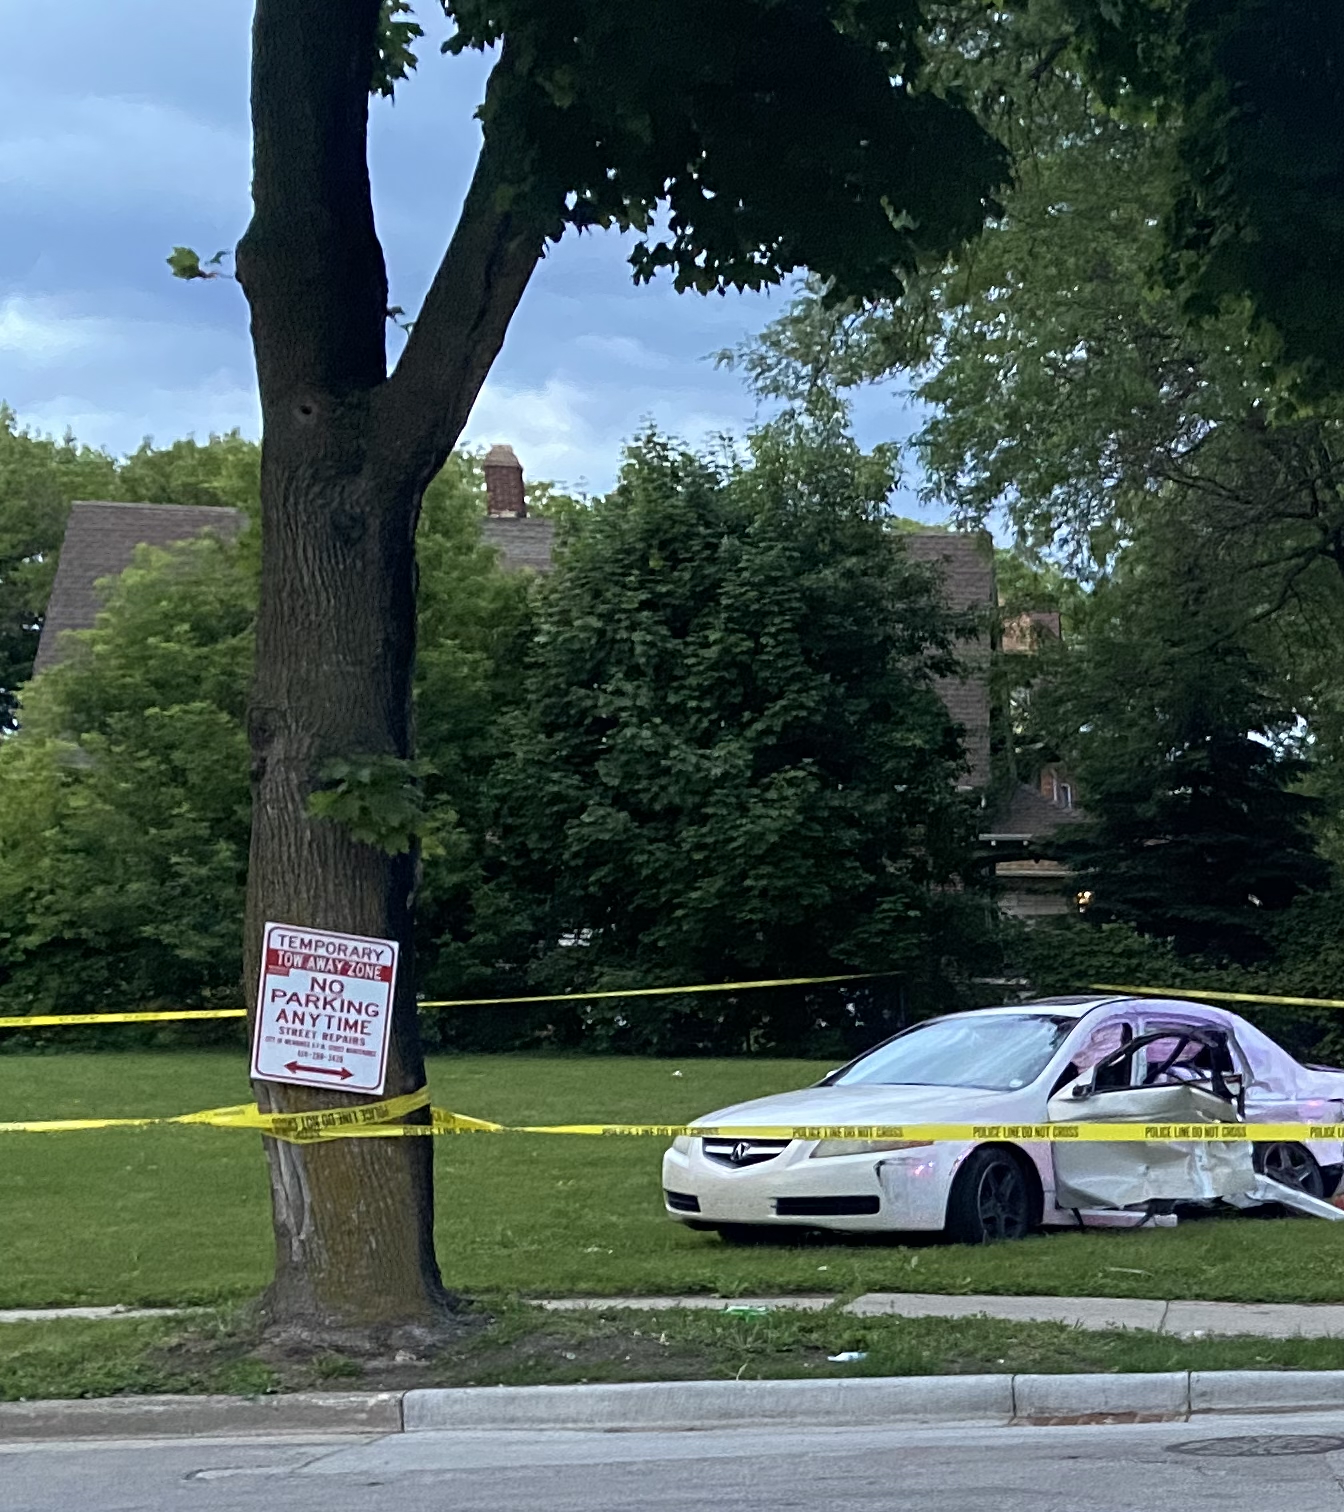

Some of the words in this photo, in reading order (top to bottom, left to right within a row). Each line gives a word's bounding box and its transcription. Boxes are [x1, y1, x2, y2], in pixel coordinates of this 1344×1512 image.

[278, 934, 385, 962] TEMPORARY
[277, 952, 302, 969] TOW
[306, 955, 345, 974] AWAY
[347, 961, 382, 980] ZONE
[310, 976, 345, 994] NO
[270, 988, 379, 1018] PARKING
[276, 1008, 372, 1036] ANYTIME
[279, 1026, 317, 1039] STREET
[322, 1032, 366, 1047] REPAIRS
[973, 1127, 1000, 1138] POLICE
[1003, 1127, 1019, 1138] LINE
[1021, 1127, 1032, 1138] DO
[1035, 1127, 1050, 1138] NOT
[1145, 1127, 1170, 1138] POLICE
[1174, 1127, 1190, 1138] LINE
[1192, 1127, 1202, 1138] DO
[1204, 1127, 1219, 1138] NOT
[1311, 1127, 1335, 1138] POLICE
